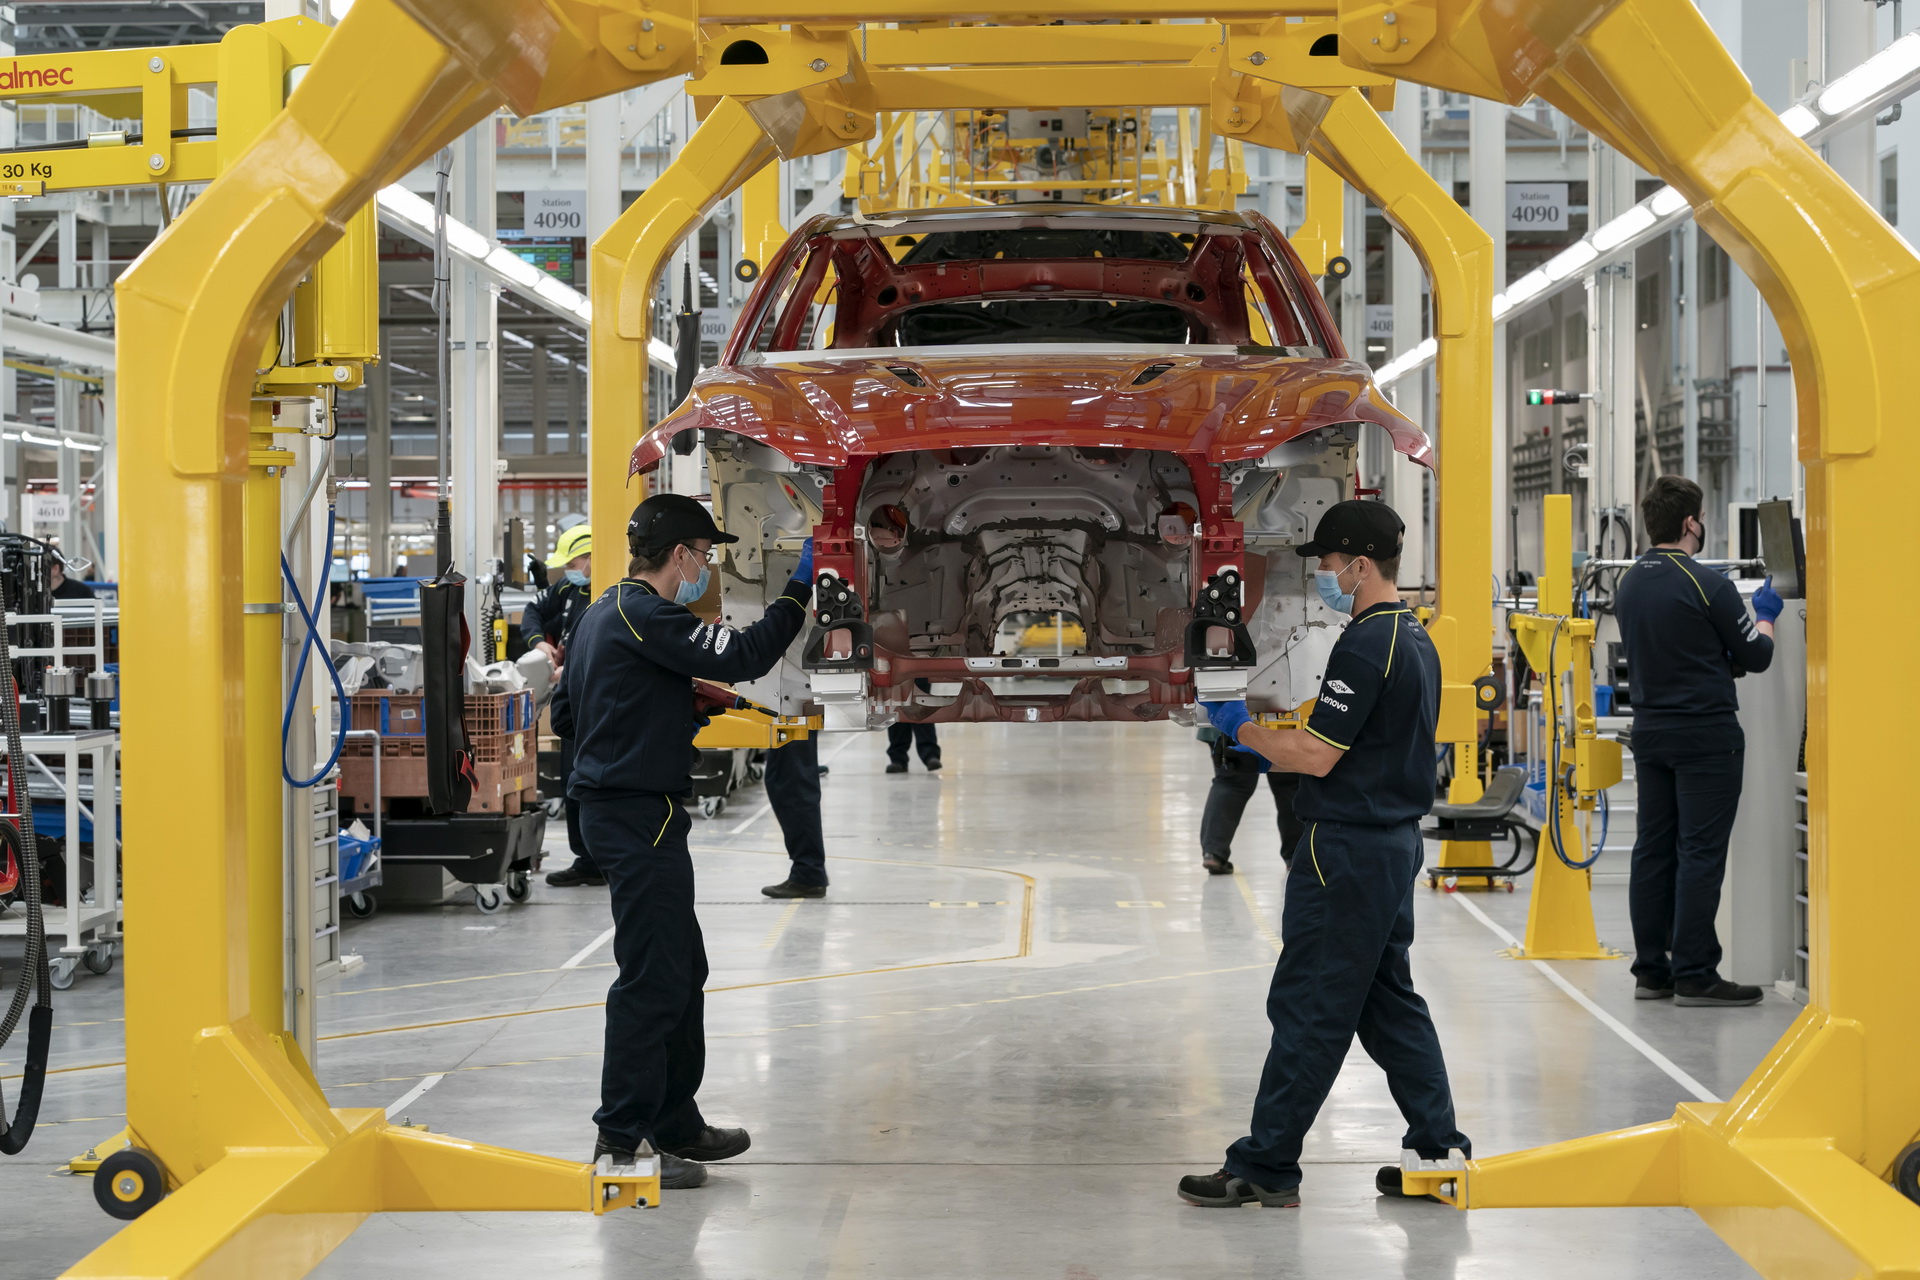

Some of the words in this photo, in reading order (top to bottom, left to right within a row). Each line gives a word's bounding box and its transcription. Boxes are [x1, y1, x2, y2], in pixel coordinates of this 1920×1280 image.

[3, 164, 24, 178] 30
[31, 162, 52, 178] Kg
[1520, 192, 1550, 200] Station
[541, 198, 571, 207] Station
[1512, 205, 1559, 222] 4090
[534, 212, 581, 229] 4090
[701, 323, 726, 335] 080
[1370, 320, 1393, 332] 408
[36, 507, 65, 517] 4610
[1331, 681, 1348, 692] Dow
[1320, 692, 1348, 712] Lenovo
